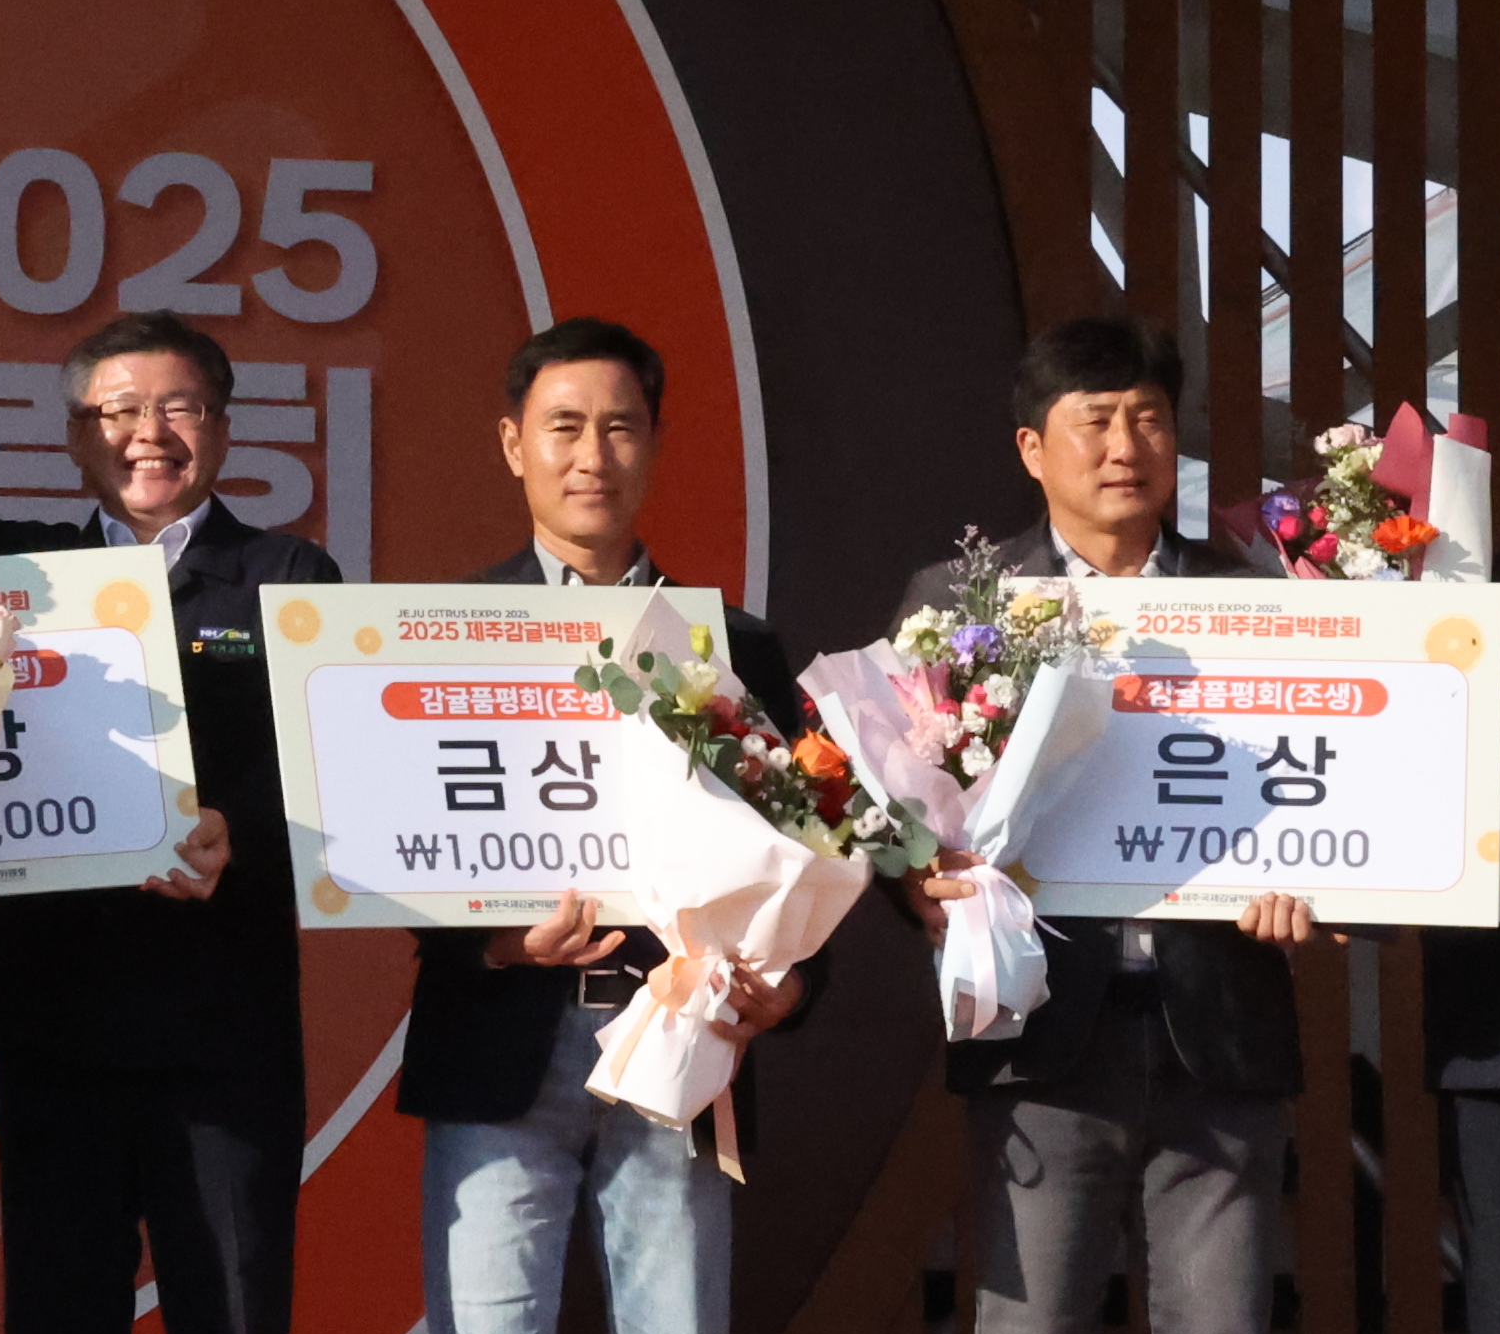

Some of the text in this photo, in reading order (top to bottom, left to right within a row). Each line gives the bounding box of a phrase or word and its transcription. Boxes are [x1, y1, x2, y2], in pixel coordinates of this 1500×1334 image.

[397, 609, 530, 618] JEJU CITRUS EXPO 2025
[1137, 603, 1282, 613] JEJU CITRUS EXPO 2025
[398, 620, 604, 643] 2025 제주감귤박람회
[1136, 614, 1362, 638] 2025 제주감귤박람회
[419, 685, 614, 718] 감귤품평회(조생)
[1148, 679, 1363, 714] 감귤품평회(조생)
[396, 832, 630, 879] ₩1,000,00
